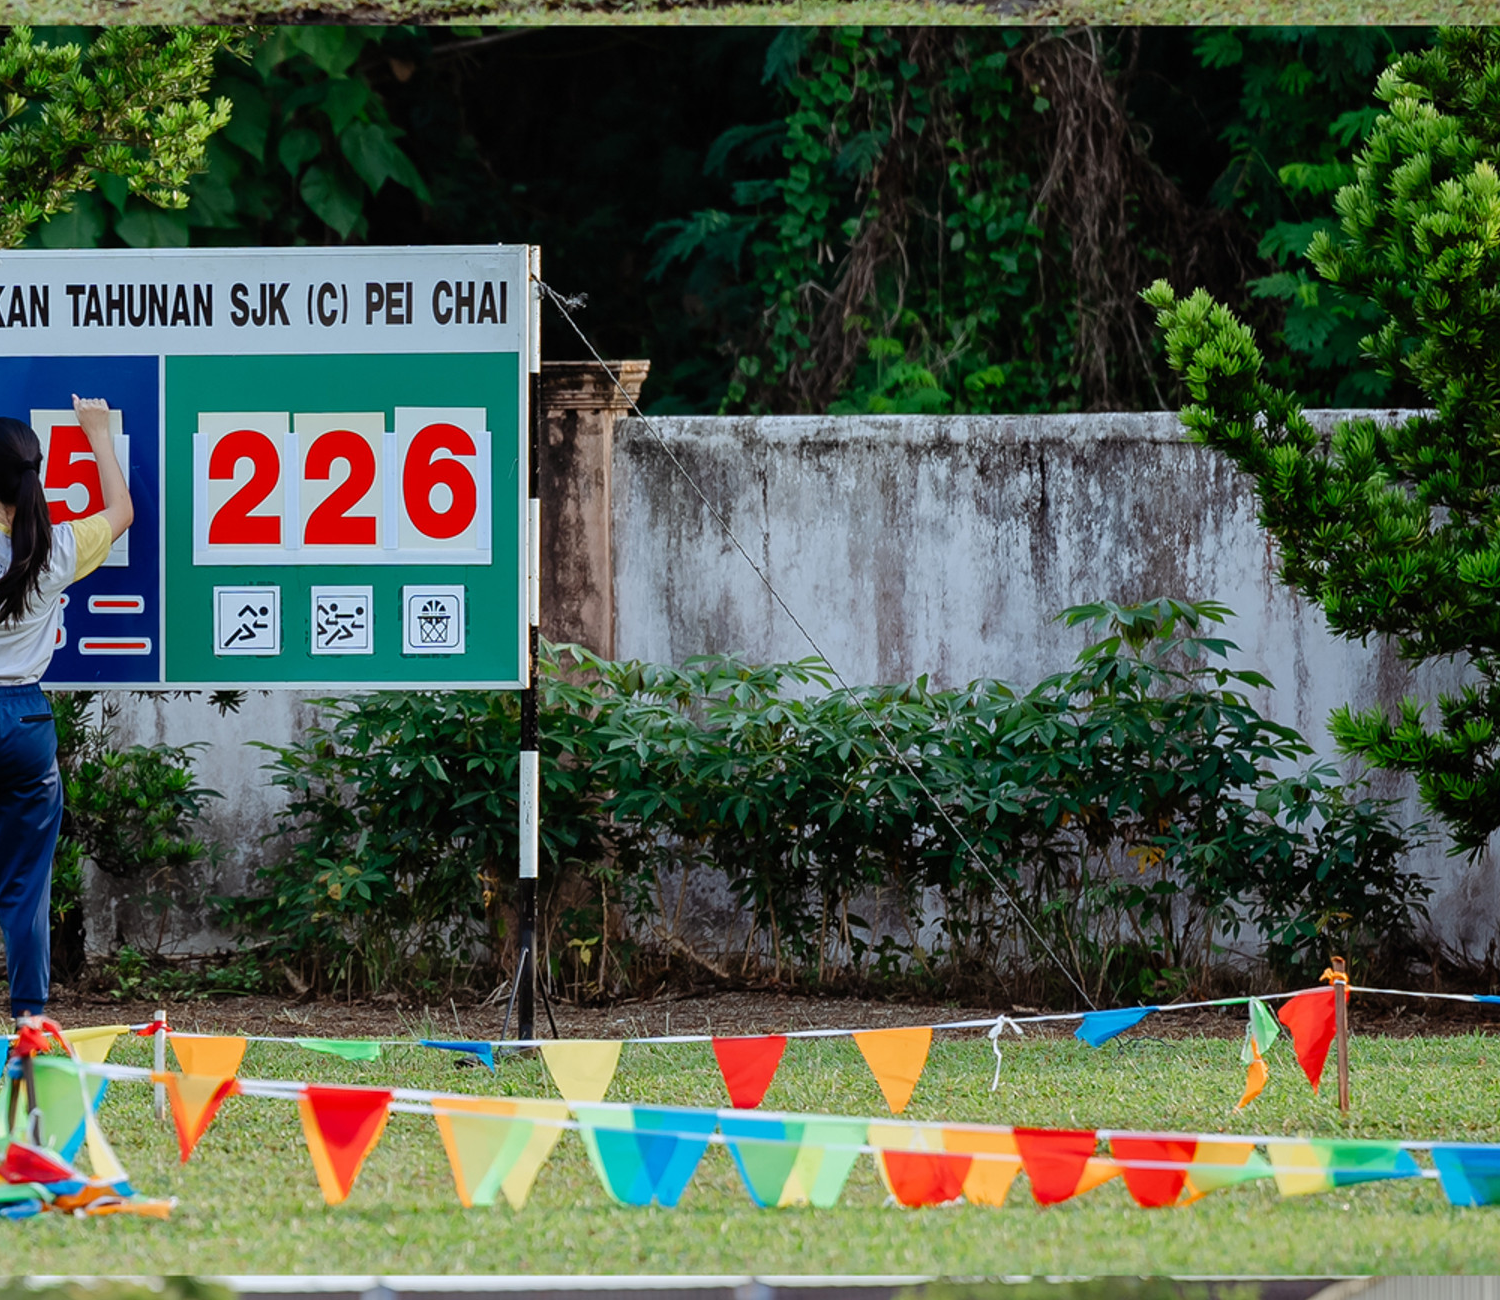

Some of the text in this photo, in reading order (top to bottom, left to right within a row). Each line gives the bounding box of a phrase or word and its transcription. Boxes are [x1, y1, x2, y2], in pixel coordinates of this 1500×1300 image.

[65, 282, 214, 328] TAHUNAN
[230, 281, 292, 327] SJK
[305, 281, 350, 326] (C)
[365, 281, 414, 325] PEI
[432, 279, 509, 325] CHAI
[44, 425, 106, 524] 5
[207, 422, 478, 547] 226
